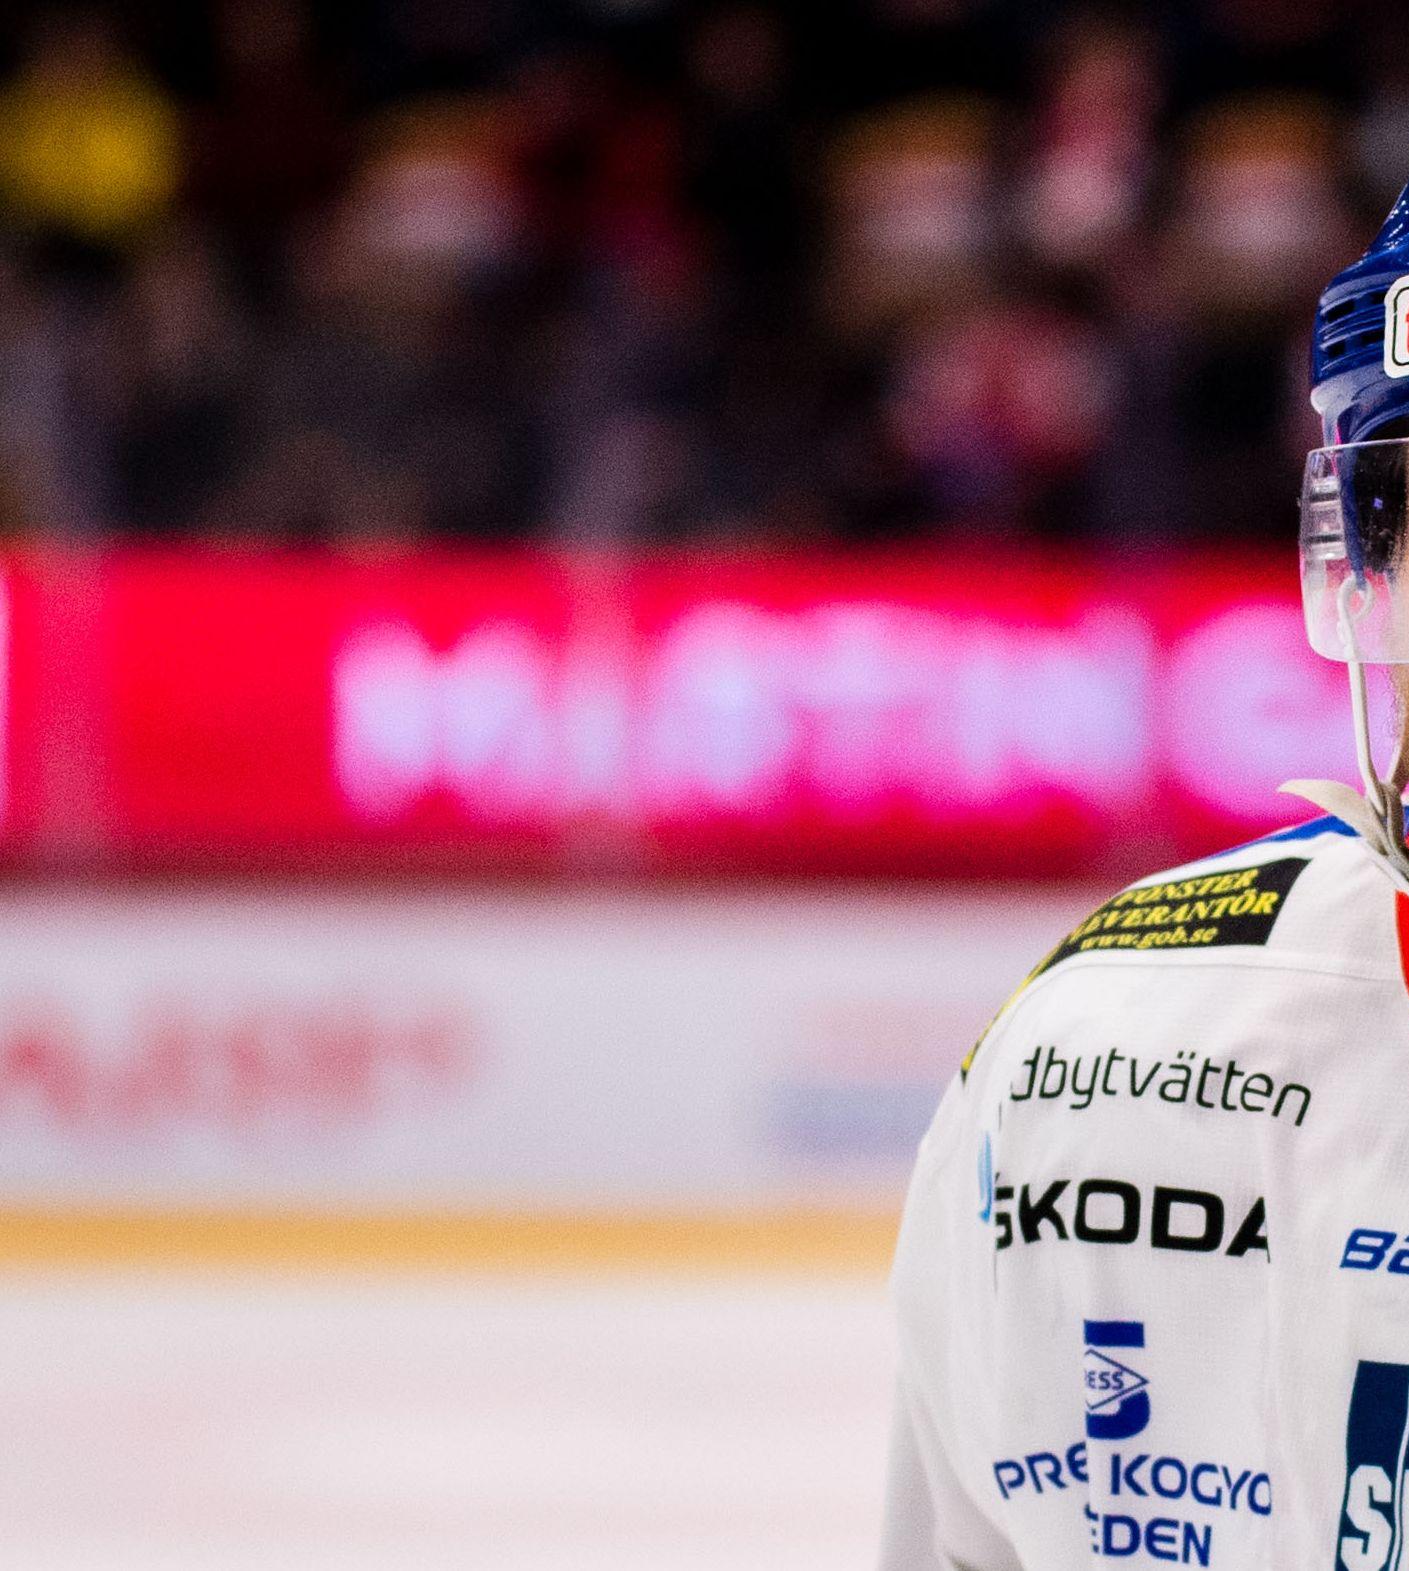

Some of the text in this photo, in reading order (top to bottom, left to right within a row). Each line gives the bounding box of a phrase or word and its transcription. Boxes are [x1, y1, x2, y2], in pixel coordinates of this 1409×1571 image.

[1080, 926, 1219, 951] www.gob.se
[1084, 1370, 1125, 1390] ESS
[992, 1441, 1090, 1500] PRE
[1086, 1503, 1212, 1568] DEN
